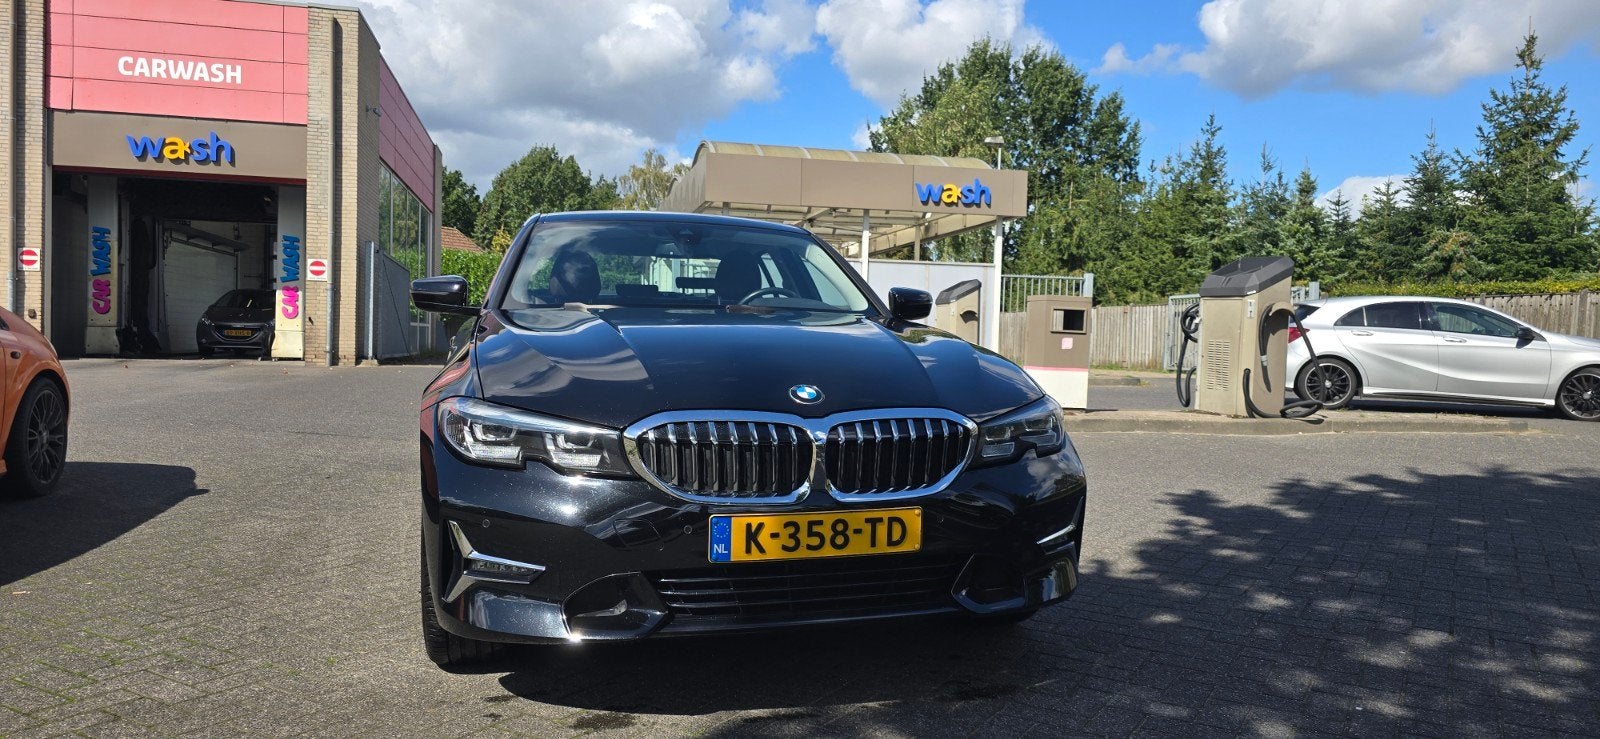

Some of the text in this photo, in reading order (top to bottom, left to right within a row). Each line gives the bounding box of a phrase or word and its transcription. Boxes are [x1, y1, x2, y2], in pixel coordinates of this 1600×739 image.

[118, 56, 242, 84] CARWASH
[125, 131, 234, 165] wash
[915, 178, 991, 207] wash
[91, 226, 111, 315] CAR WASH
[280, 235, 300, 319] CAR WASH
[713, 516, 907, 555] NL K-358-TD
